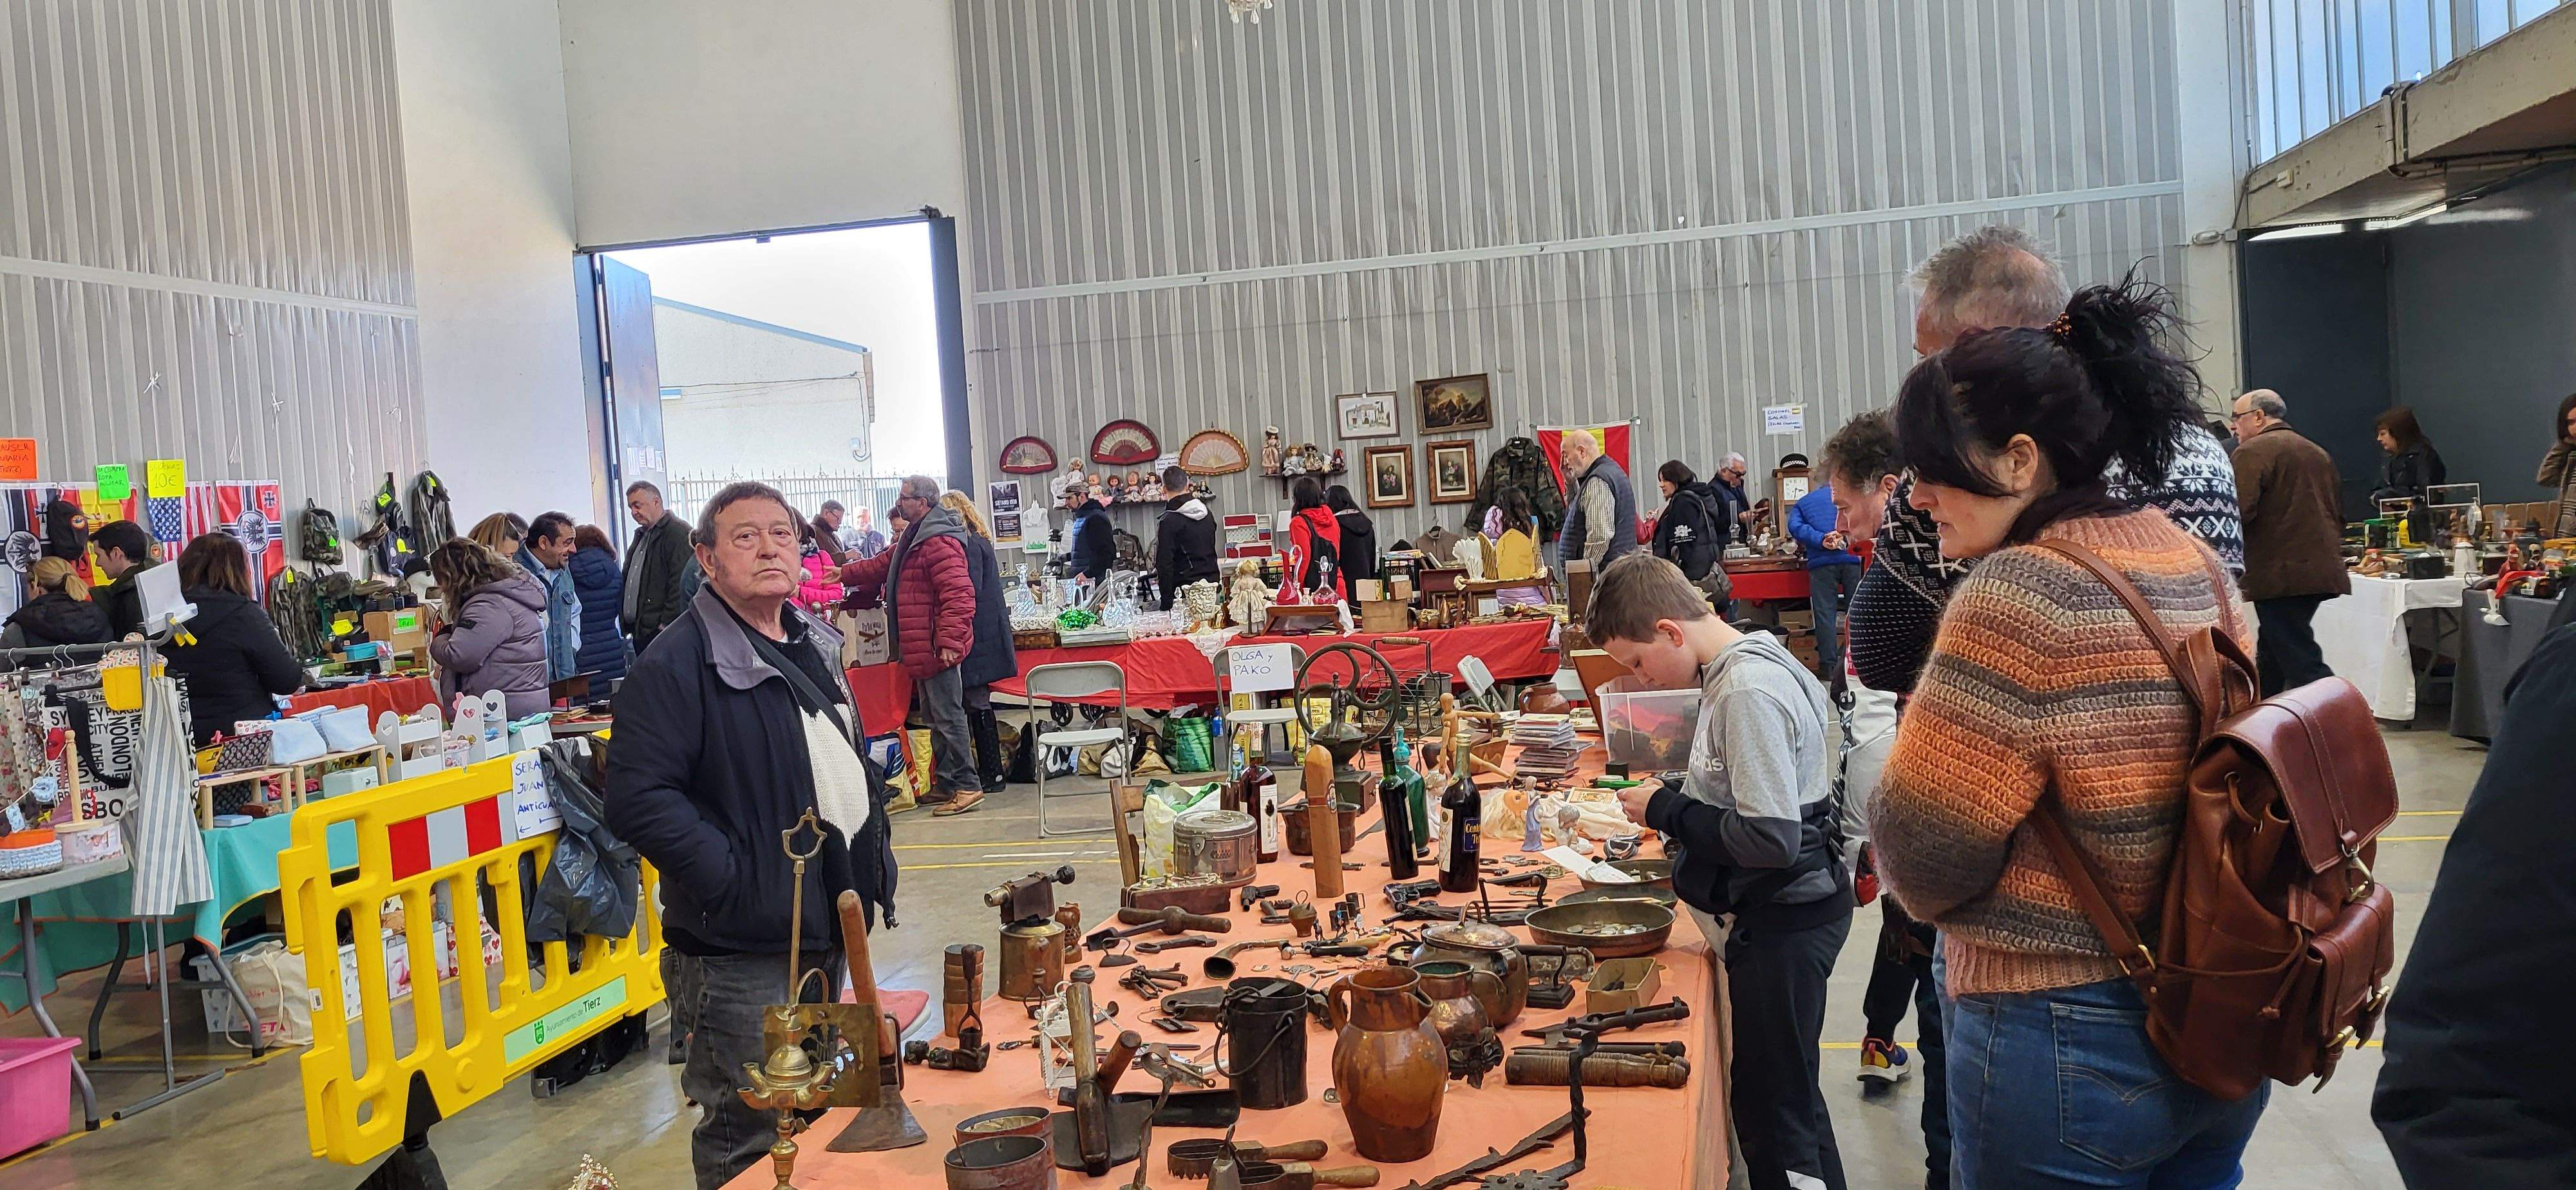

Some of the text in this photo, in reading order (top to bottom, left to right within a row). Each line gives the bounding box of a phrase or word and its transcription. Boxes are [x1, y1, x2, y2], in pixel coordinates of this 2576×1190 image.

[155, 473, 177, 489] 10€
[1231, 650, 1264, 662] OLGA
[1234, 665, 1271, 676] PAKO
[517, 780, 544, 794] JUAN
[583, 996, 601, 1013] Tierz
